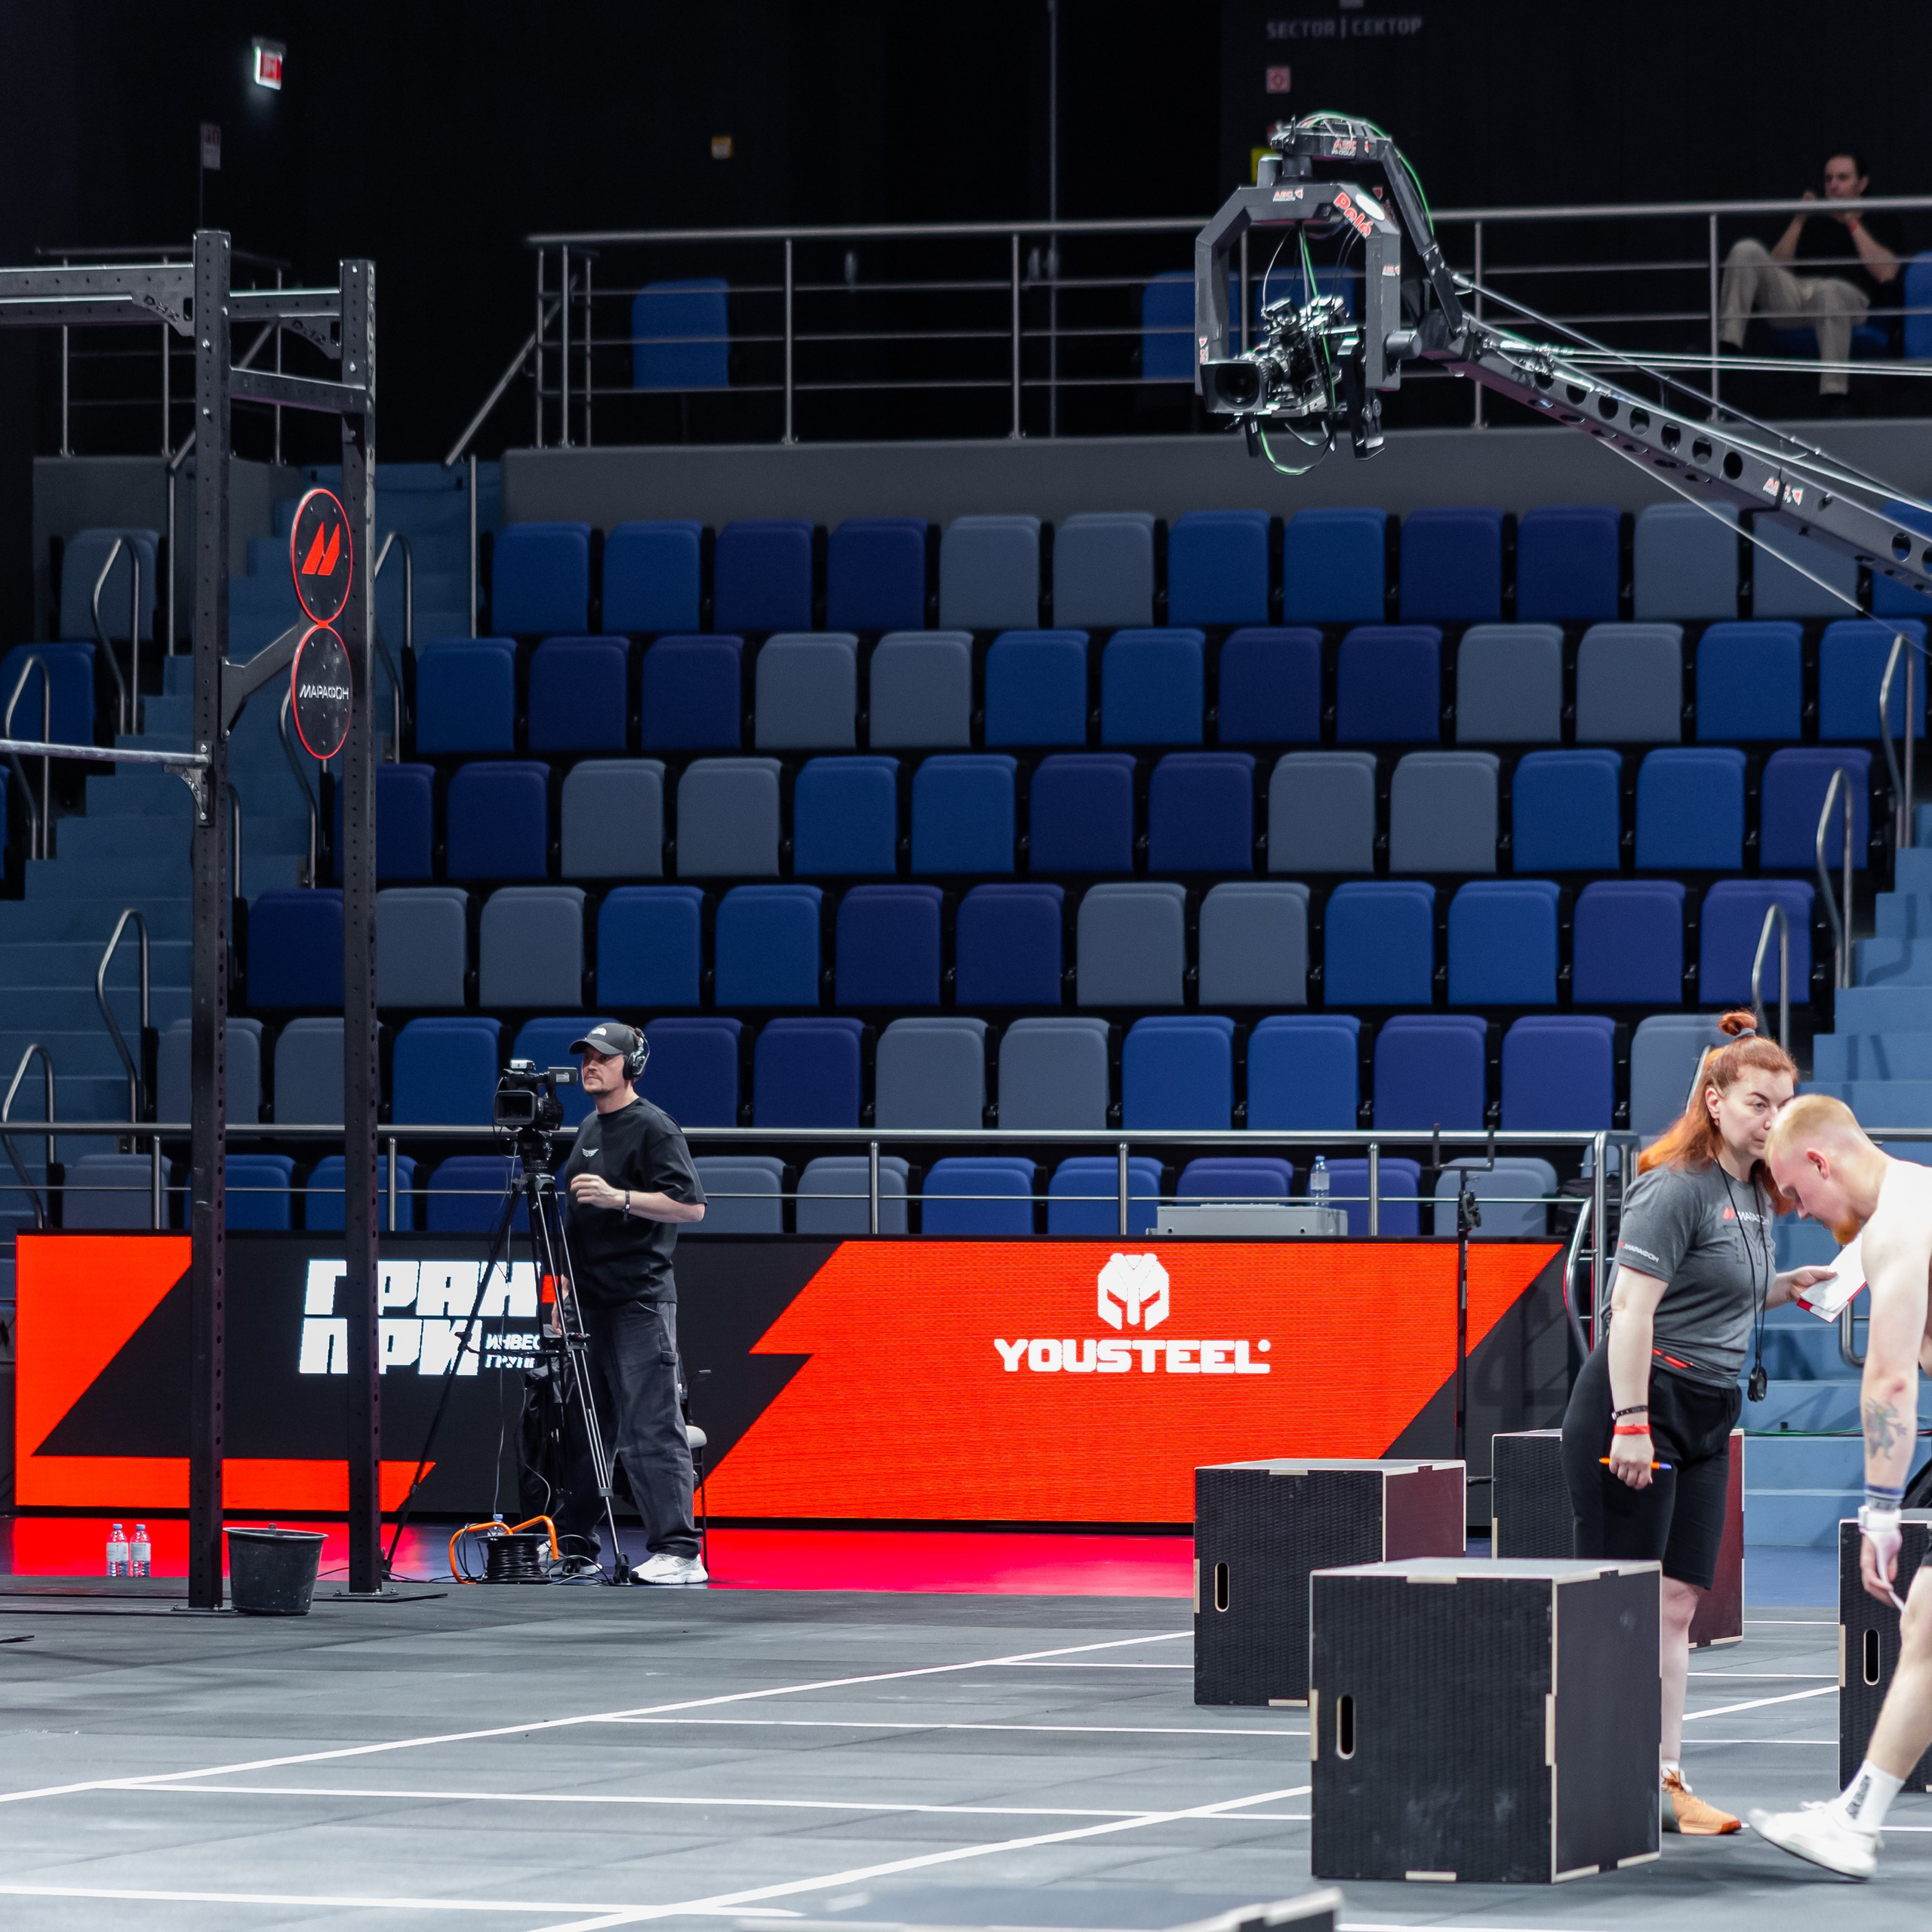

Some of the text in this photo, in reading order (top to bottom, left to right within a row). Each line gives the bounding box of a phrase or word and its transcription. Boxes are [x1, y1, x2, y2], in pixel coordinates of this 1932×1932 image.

[1266, 20, 1335, 39] SECTOR
[1352, 15, 1423, 37] СЕКТОР
[1333, 192, 1374, 238] Pelé
[299, 683, 349, 700] МАРАФОН
[303, 1259, 541, 1317] ГРАН
[993, 1338, 1271, 1374] YOUSTEEL
